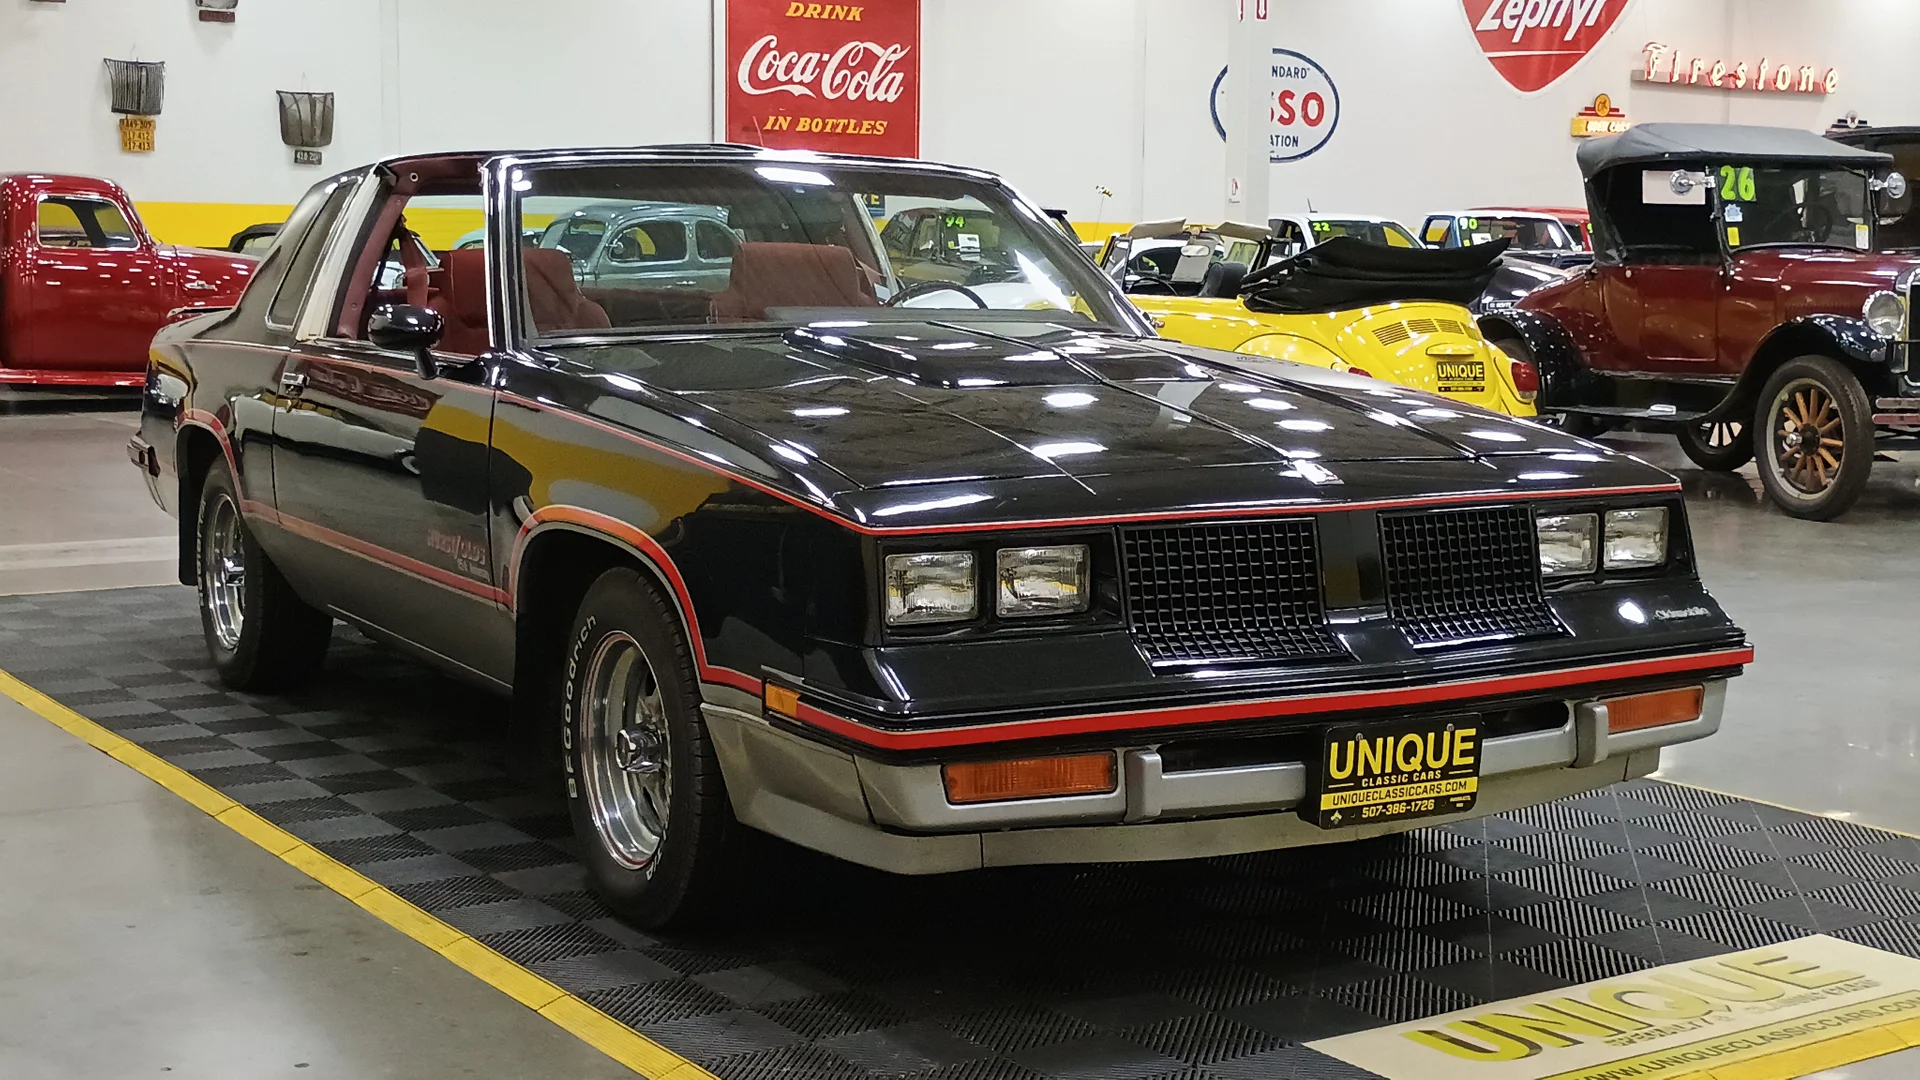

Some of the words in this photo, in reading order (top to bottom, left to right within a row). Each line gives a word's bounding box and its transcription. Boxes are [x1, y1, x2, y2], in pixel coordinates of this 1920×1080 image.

[785, 1, 864, 21] DRINK
[1476, 0, 1608, 43] Zephyr
[738, 34, 911, 103] Coca-Cola
[1642, 42, 1838, 94] Firestone
[763, 115, 792, 131] IN
[795, 116, 888, 135] BOTTLES
[1720, 165, 1756, 201] 26
[945, 216, 966, 228] 94
[1312, 221, 1331, 232] 22
[1459, 217, 1478, 230] 90
[1437, 363, 1484, 378] UNIQUE
[1329, 727, 1477, 780] UNIQUE
[1361, 773, 1409, 788] CLASSIC
[1412, 769, 1442, 782] CARS
[1332, 779, 1468, 807] UNIQUECLASSICCARS.COM
[1361, 799, 1436, 819] 507-386-1726
[1400, 950, 1868, 1062] UNIQUE
[1574, 996, 1920, 1080] WW.UNIQUECLASSICCARS.CO
